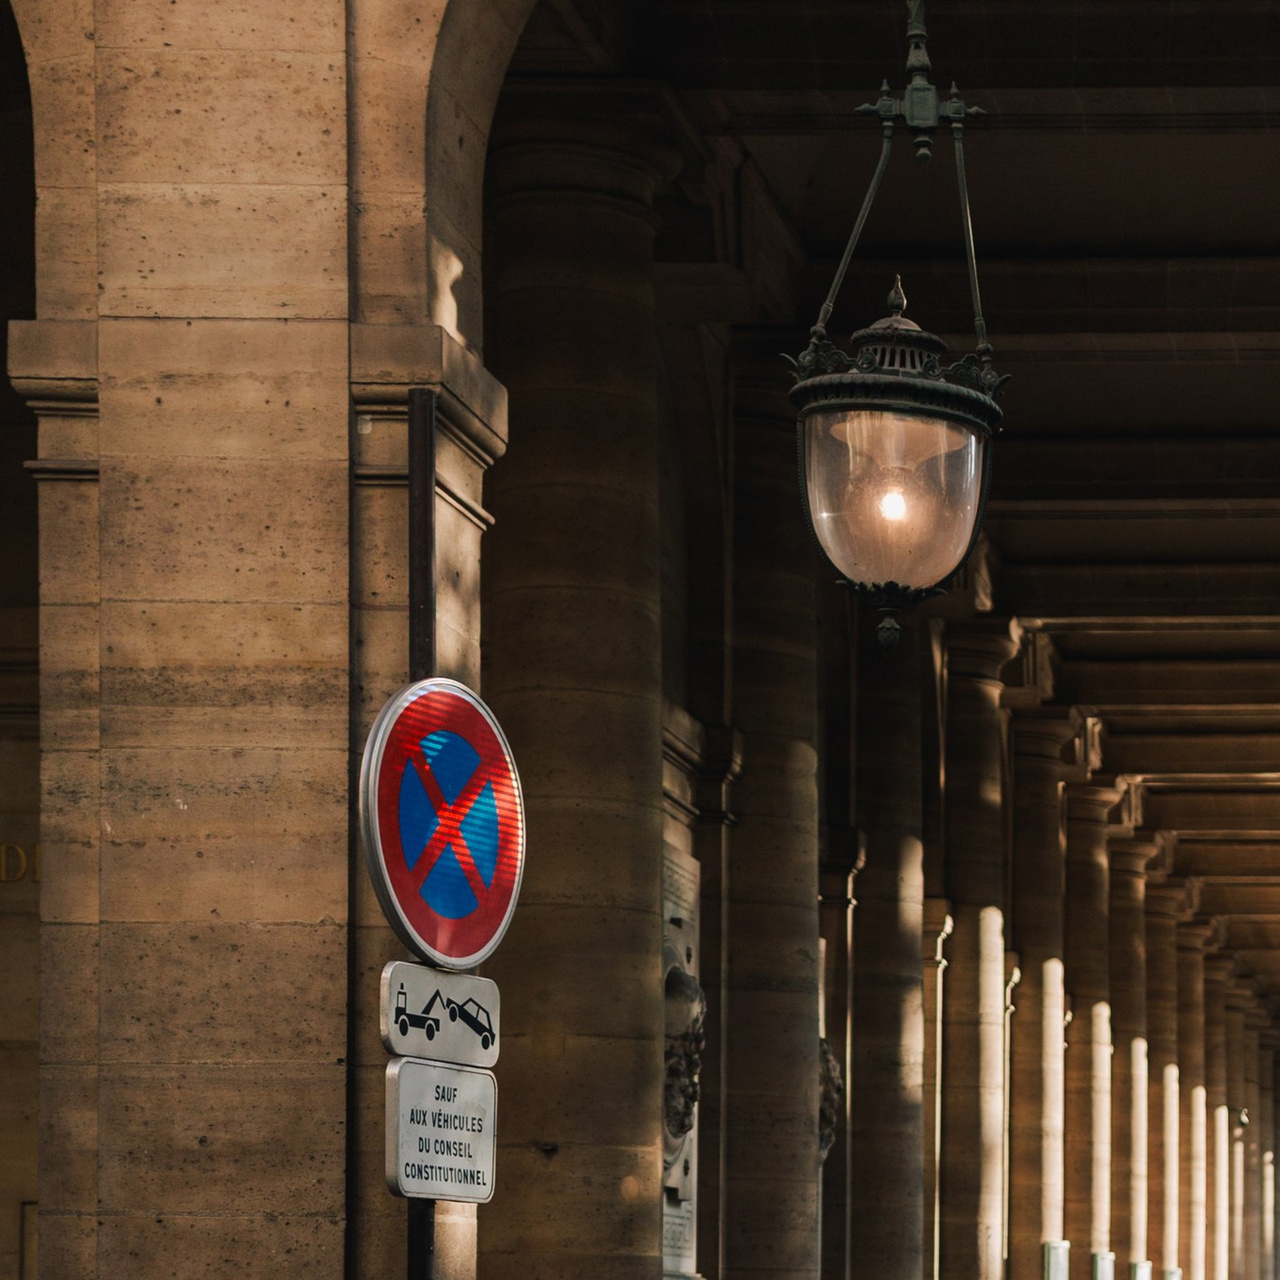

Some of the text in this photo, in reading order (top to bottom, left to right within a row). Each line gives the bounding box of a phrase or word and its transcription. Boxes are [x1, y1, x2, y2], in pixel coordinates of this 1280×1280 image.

[435, 1085, 457, 1103] SAUF
[410, 1109, 483, 1133] AUX VÉHICULES
[418, 1137, 473, 1159] DU CONSEIL
[404, 1162, 487, 1186] CONSTITUTIONNEL
